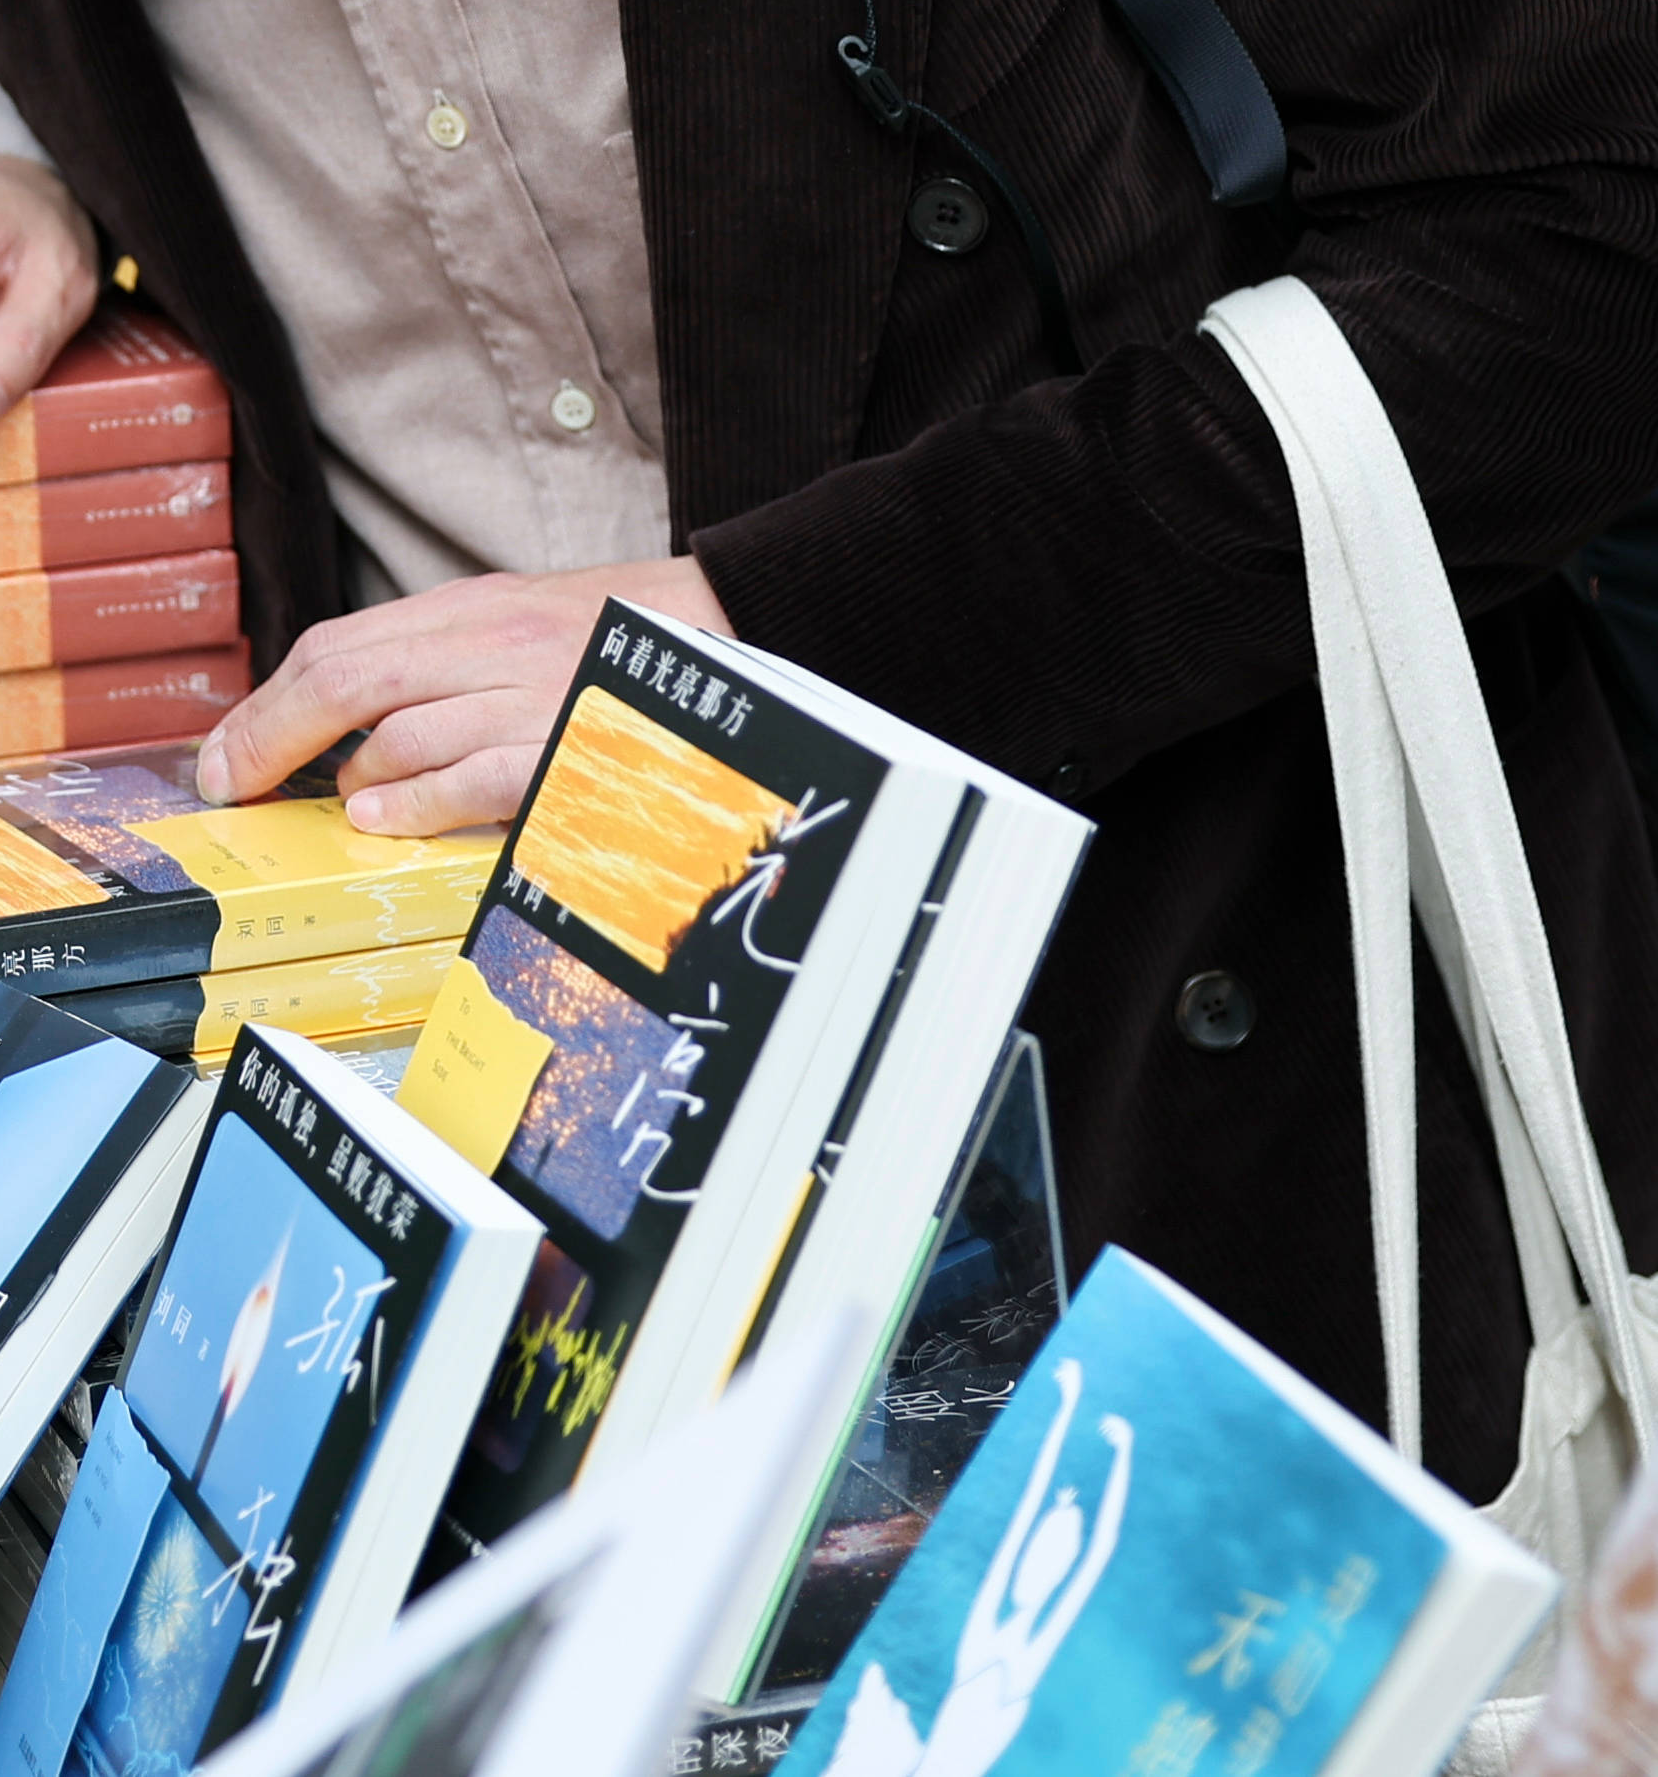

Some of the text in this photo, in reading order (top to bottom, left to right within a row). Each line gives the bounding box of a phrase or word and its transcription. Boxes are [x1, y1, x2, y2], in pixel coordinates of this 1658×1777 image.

[600, 623, 755, 738] 向着光亮那方
[235, 915, 285, 940] 刘同
[220, 997, 270, 1021] 刘同
[155, 1285, 193, 1342] 刘同
